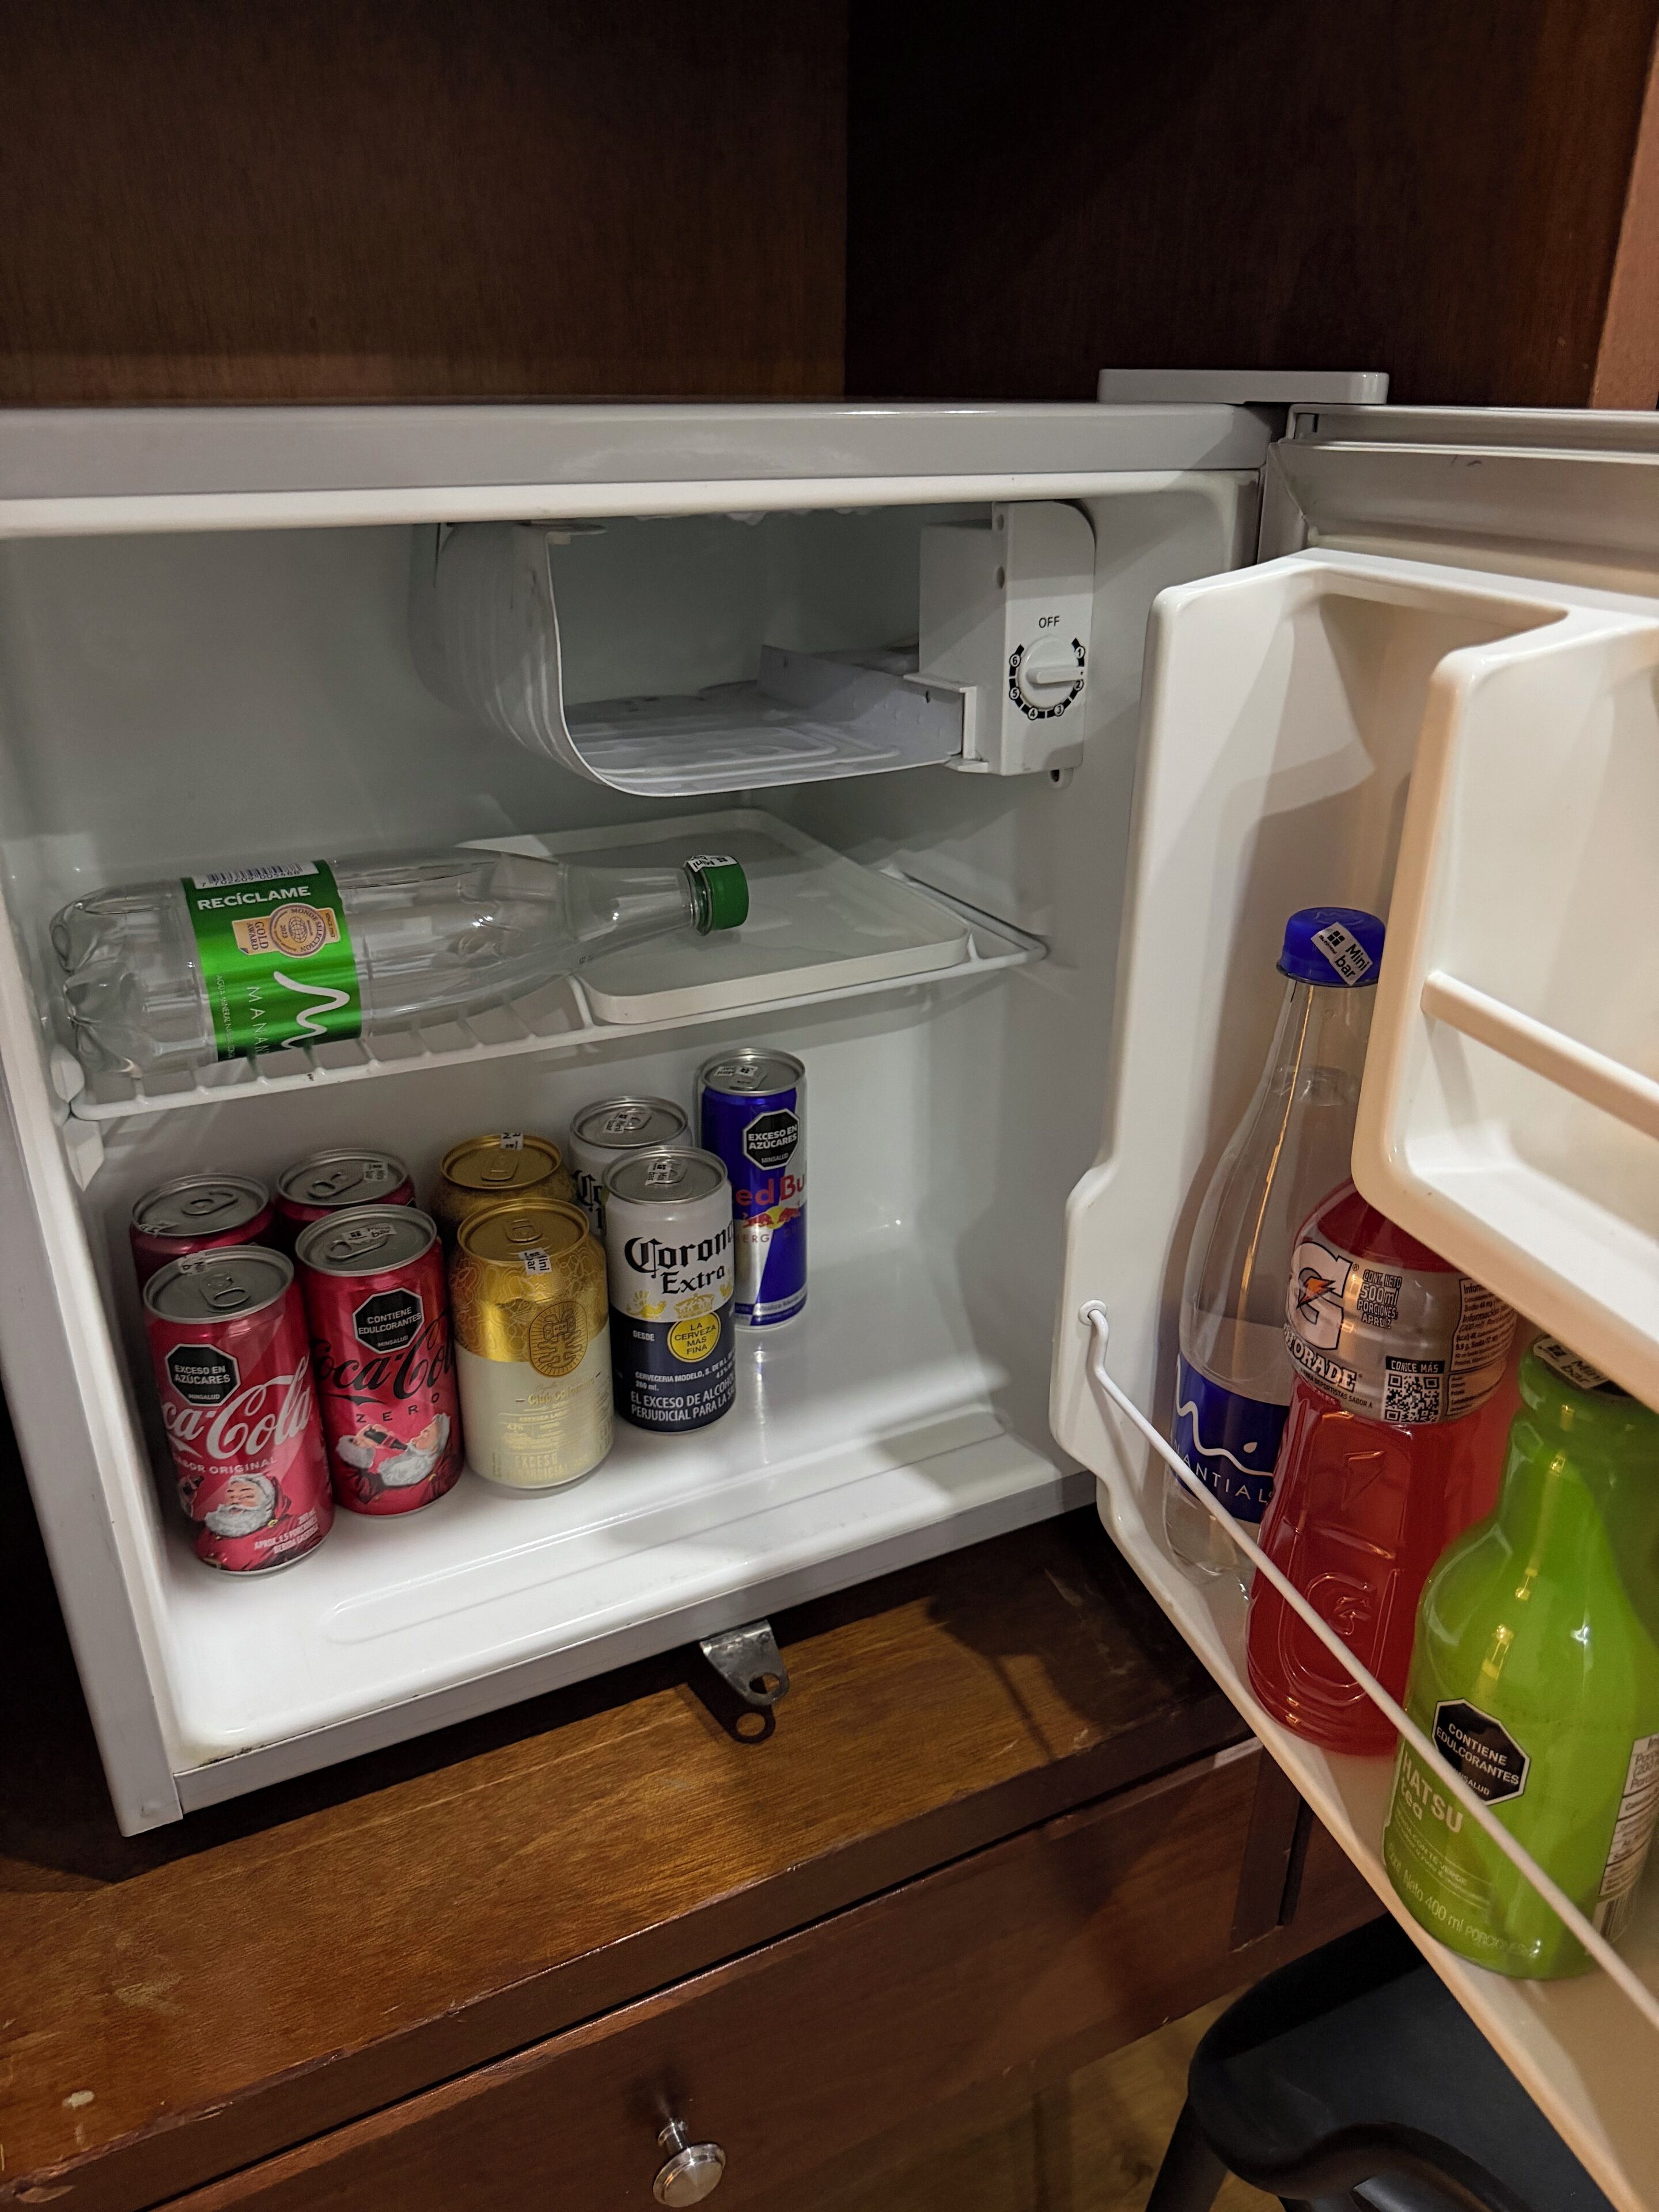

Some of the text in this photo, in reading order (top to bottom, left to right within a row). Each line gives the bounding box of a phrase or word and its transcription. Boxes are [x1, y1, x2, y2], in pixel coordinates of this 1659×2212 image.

[1039, 616, 1060, 628] OFF
[197, 885, 312, 910] RECÍCLAME
[290, 907, 317, 922] MONDE
[247, 922, 259, 950] AWARD
[255, 921, 270, 949] GOLD
[1334, 955, 1356, 978] bar
[1345, 943, 1370, 972] Mini
[748, 1124, 797, 1141] EXCESO EN
[748, 1132, 797, 1150] AZÚCARES
[735, 1178, 774, 1206] ed
[660, 1265, 725, 1294] Extra
[358, 1312, 422, 1335] EDULCORANTES
[367, 1306, 412, 1324] CONTIENE
[632, 1330, 655, 1342] DESDE
[674, 1325, 717, 1342] CERVEZA
[691, 1323, 703, 1331] LA
[378, 1335, 408, 1347] MINSALUD
[686, 1344, 708, 1355] FINA
[687, 1336, 707, 1347] MAS
[174, 1365, 226, 1374] EXCESO EN
[674, 1370, 705, 1382] MODELO,
[1421, 1361, 1438, 1373] MÁS
[174, 1374, 231, 1385] AZÚCARES
[355, 1392, 440, 1423] ZERO
[527, 1393, 551, 1406] Club
[630, 1391, 642, 1405] EL
[643, 1395, 684, 1410] EXCESO
[686, 1392, 701, 1406] DE
[631, 1393, 727, 1422] PERJUDICIAL PARA LA
[1349, 1395, 1368, 1406] SABOR
[209, 1457, 278, 1475] ORIGINAL
[1448, 1722, 1508, 1767] CONTIENE
[1436, 1726, 1520, 1786] EDULCORANTES
[1400, 1778, 1423, 1821] tea
[1402, 1752, 1464, 1834] HATSU
[1425, 1896, 1448, 1921] 400
